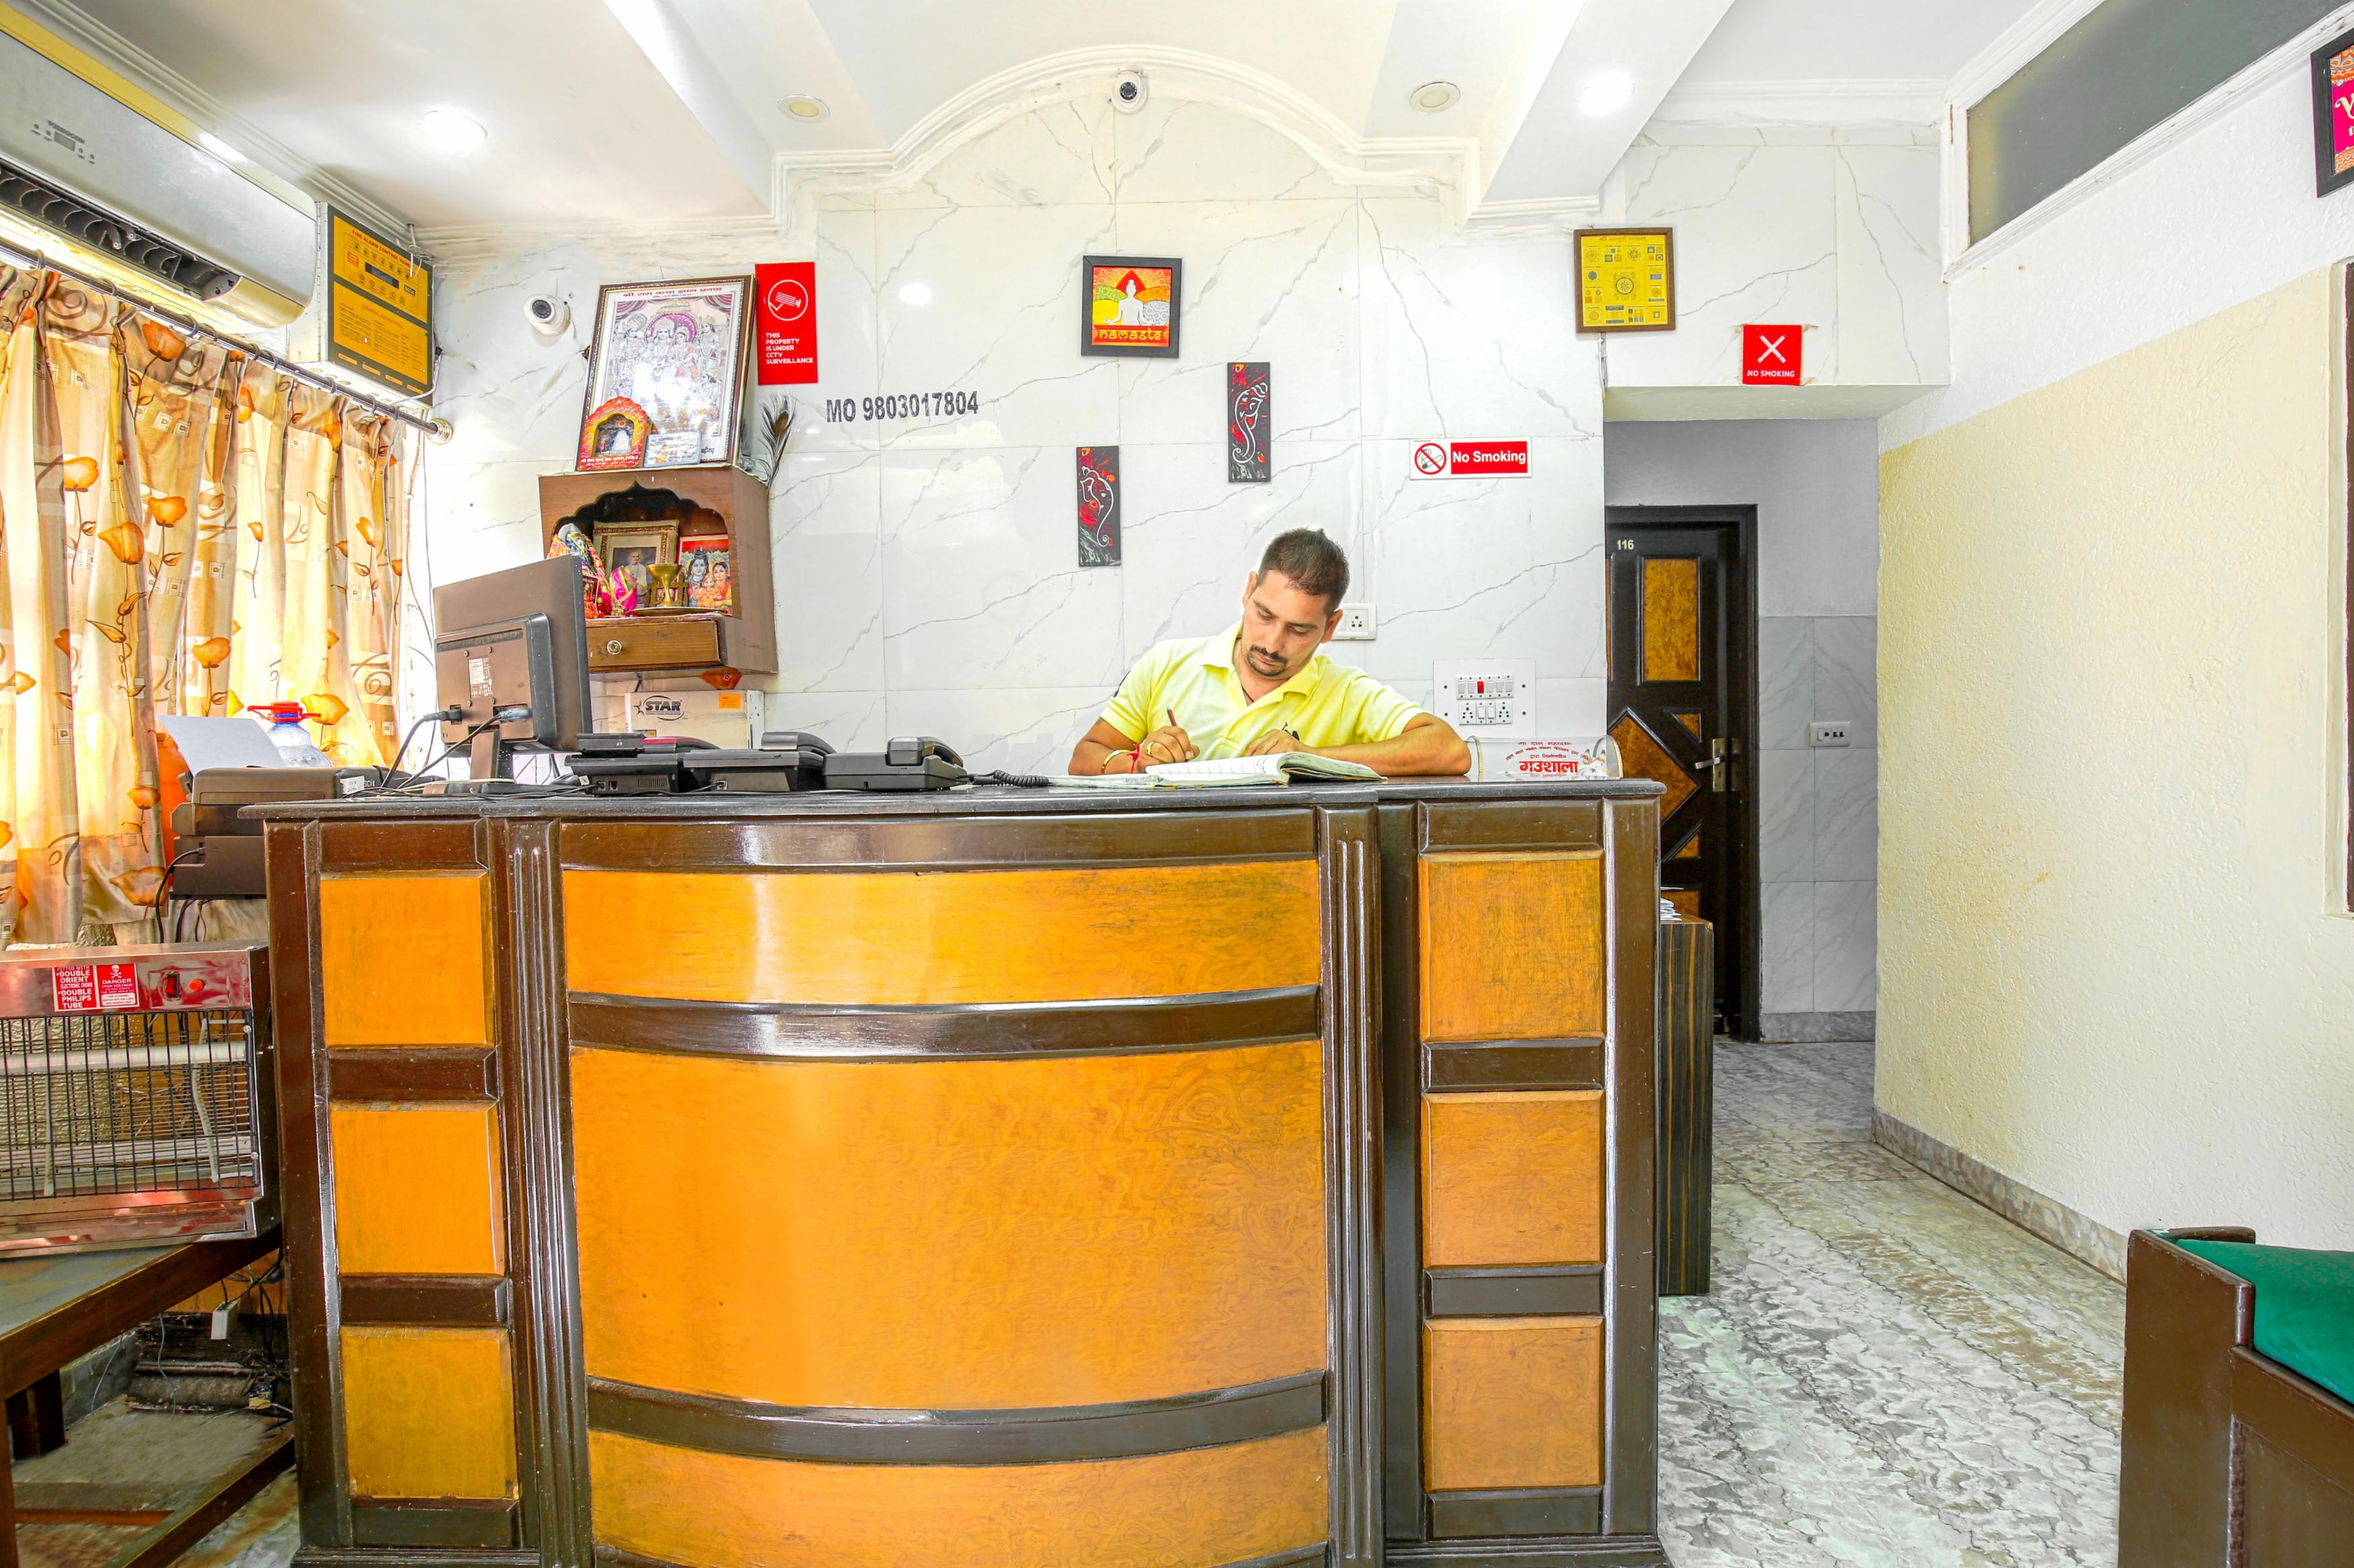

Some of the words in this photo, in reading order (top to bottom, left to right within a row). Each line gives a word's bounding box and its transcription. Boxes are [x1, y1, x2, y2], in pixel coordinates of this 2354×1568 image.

[352, 230, 363, 239] FIRE
[363, 236, 379, 249] ALARM
[379, 245, 399, 261] CONTROL
[1099, 327, 1162, 340] namaste
[827, 398, 856, 423] MO
[862, 391, 979, 422] 9803017804
[1452, 451, 1470, 463] No
[1472, 450, 1526, 465] Smoking
[1616, 539, 1634, 550] 116
[645, 701, 681, 711] STAR
[1519, 761, 1579, 773] गउशाला
